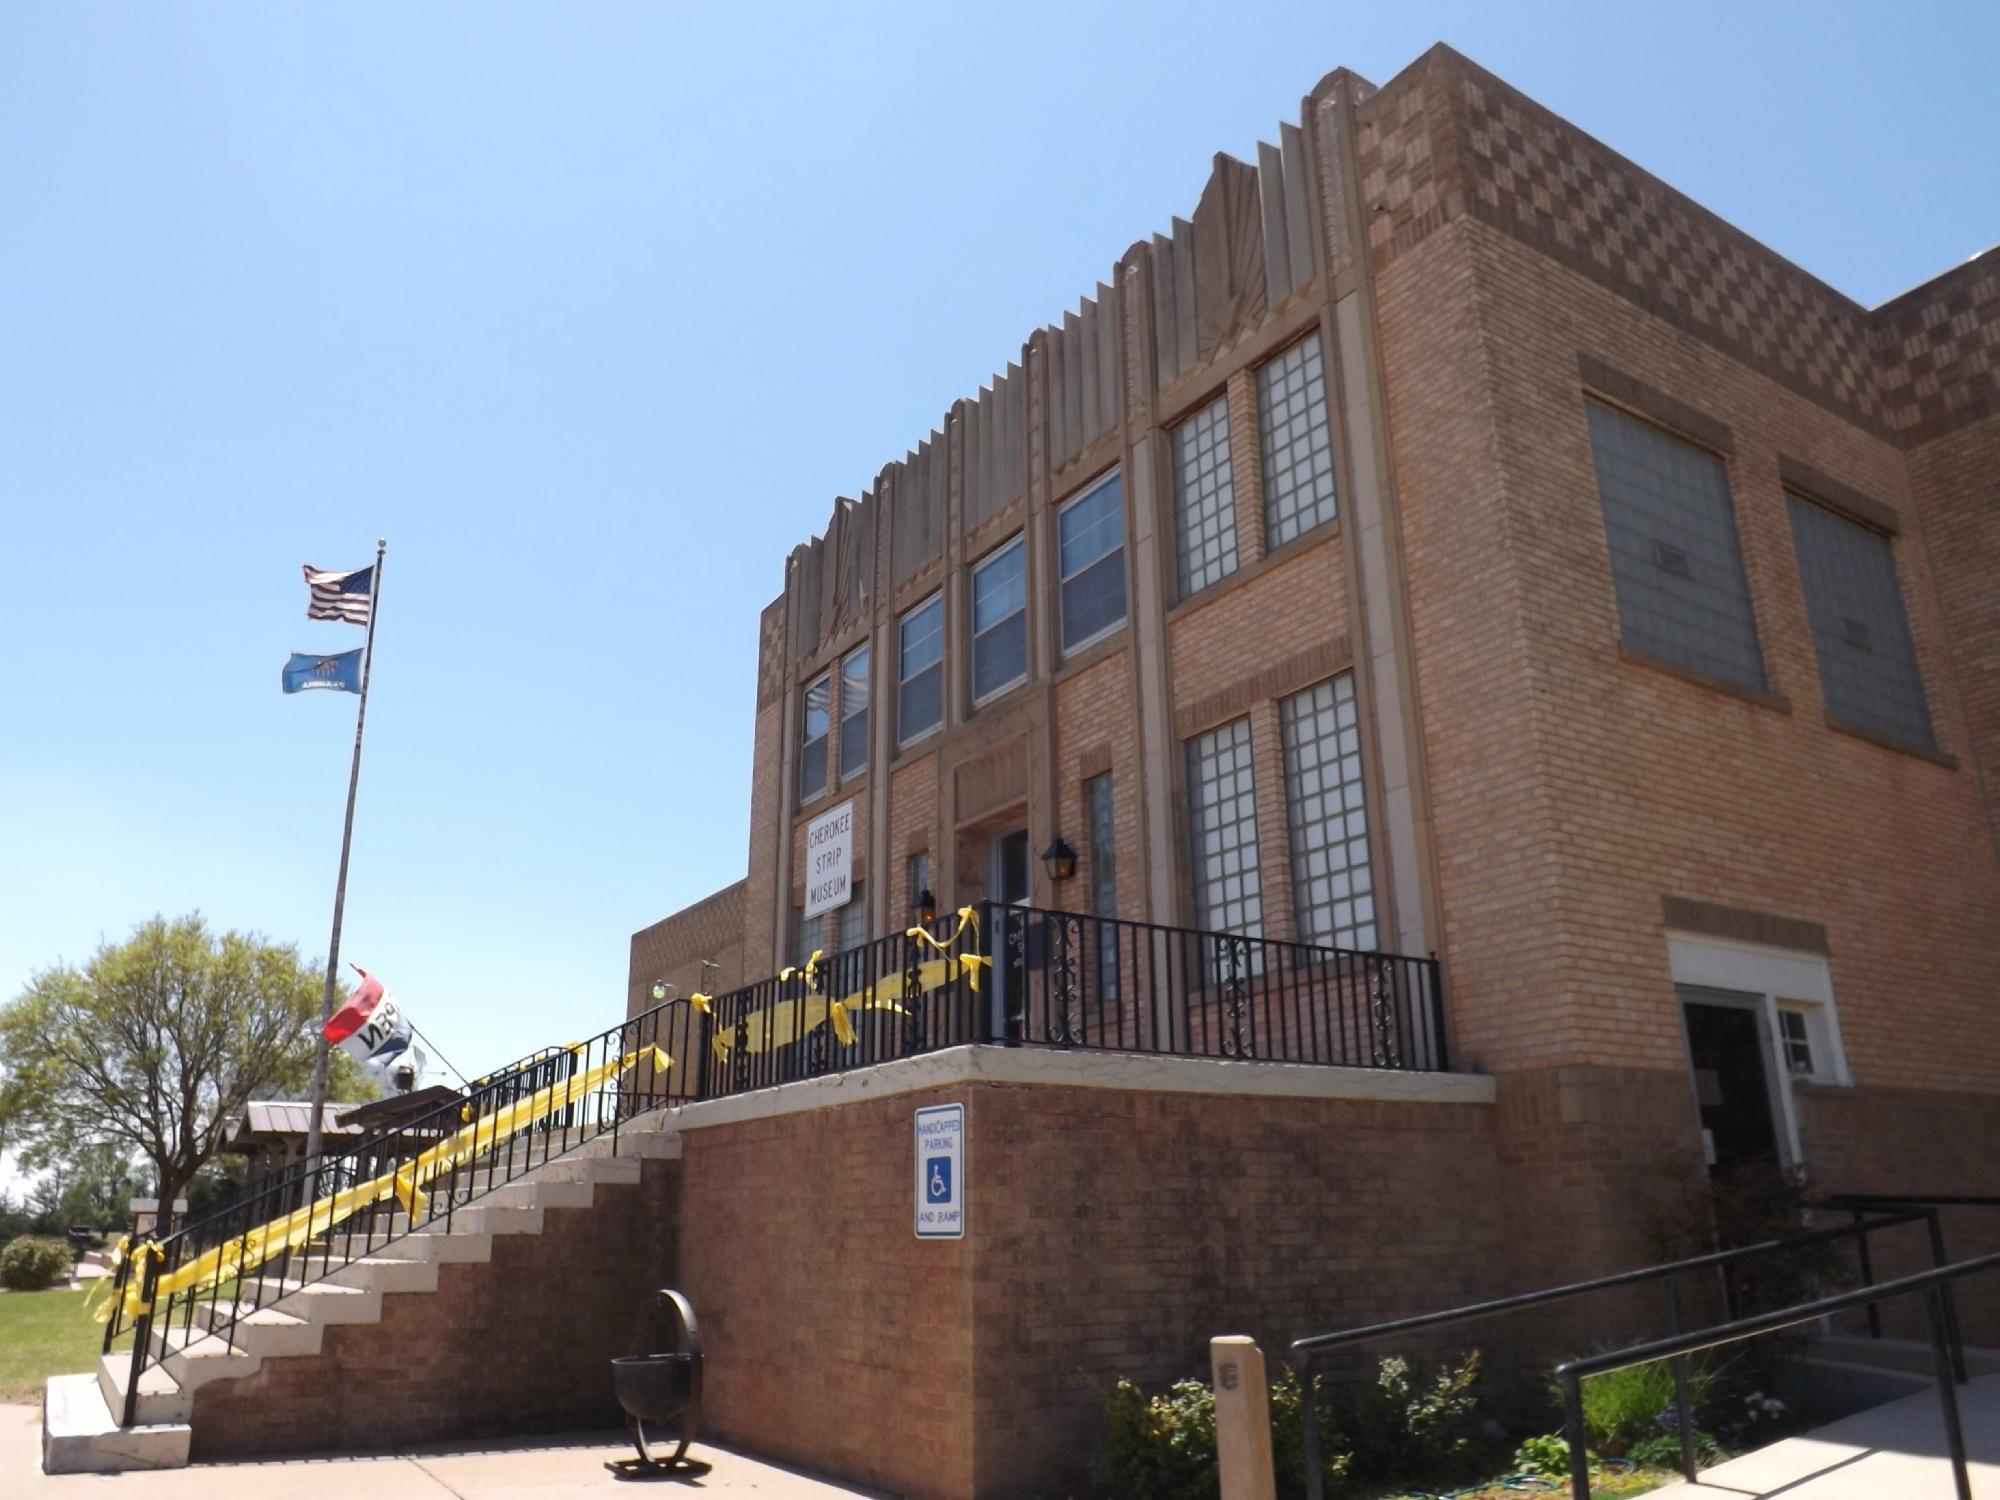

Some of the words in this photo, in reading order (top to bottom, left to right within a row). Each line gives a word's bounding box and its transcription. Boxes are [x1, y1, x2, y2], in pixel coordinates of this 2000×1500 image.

[809, 812, 850, 849] CHEROKEE
[816, 847, 842, 875] STRIP
[811, 874, 846, 905] MUSEUM
[918, 1119, 960, 1136] HANDICAPPED
[925, 1136, 953, 1152] PARKING
[919, 1210, 936, 1223] AND
[937, 1208, 960, 1223] RAMP
